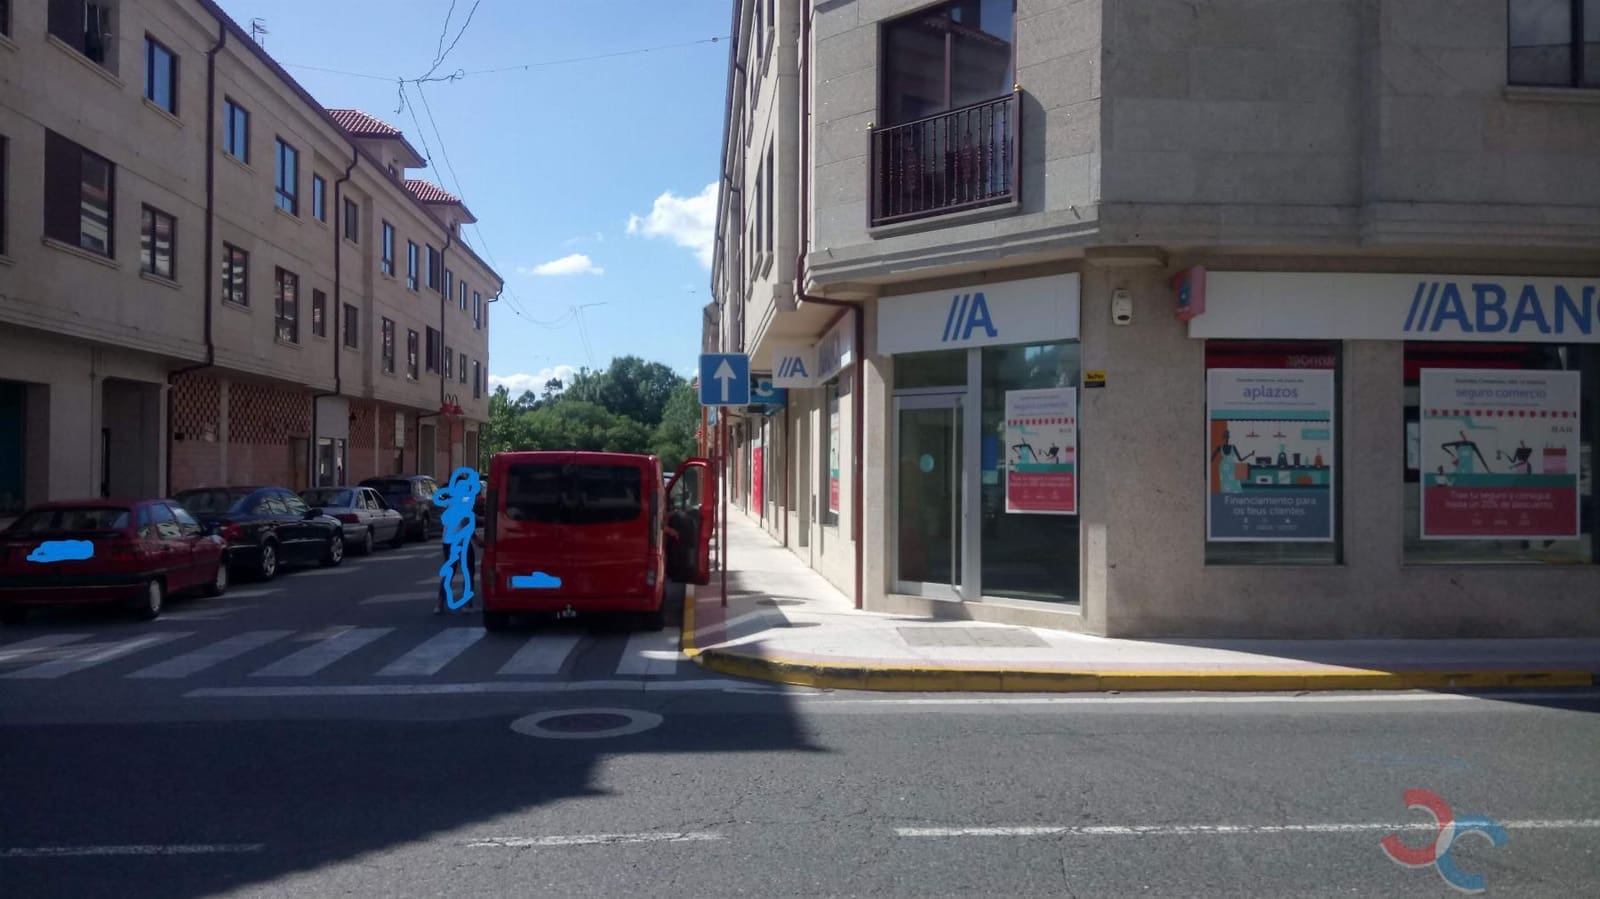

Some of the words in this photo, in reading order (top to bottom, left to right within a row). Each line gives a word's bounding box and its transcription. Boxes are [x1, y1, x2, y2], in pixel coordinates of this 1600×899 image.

[1430, 282, 1600, 335] ABAN
[1243, 385, 1299, 400] aplazos
[1455, 388, 1493, 400] seguro
[1495, 388, 1548, 400] comercio
[1224, 495, 1294, 505] Financiamento
[1295, 497, 1317, 507] para
